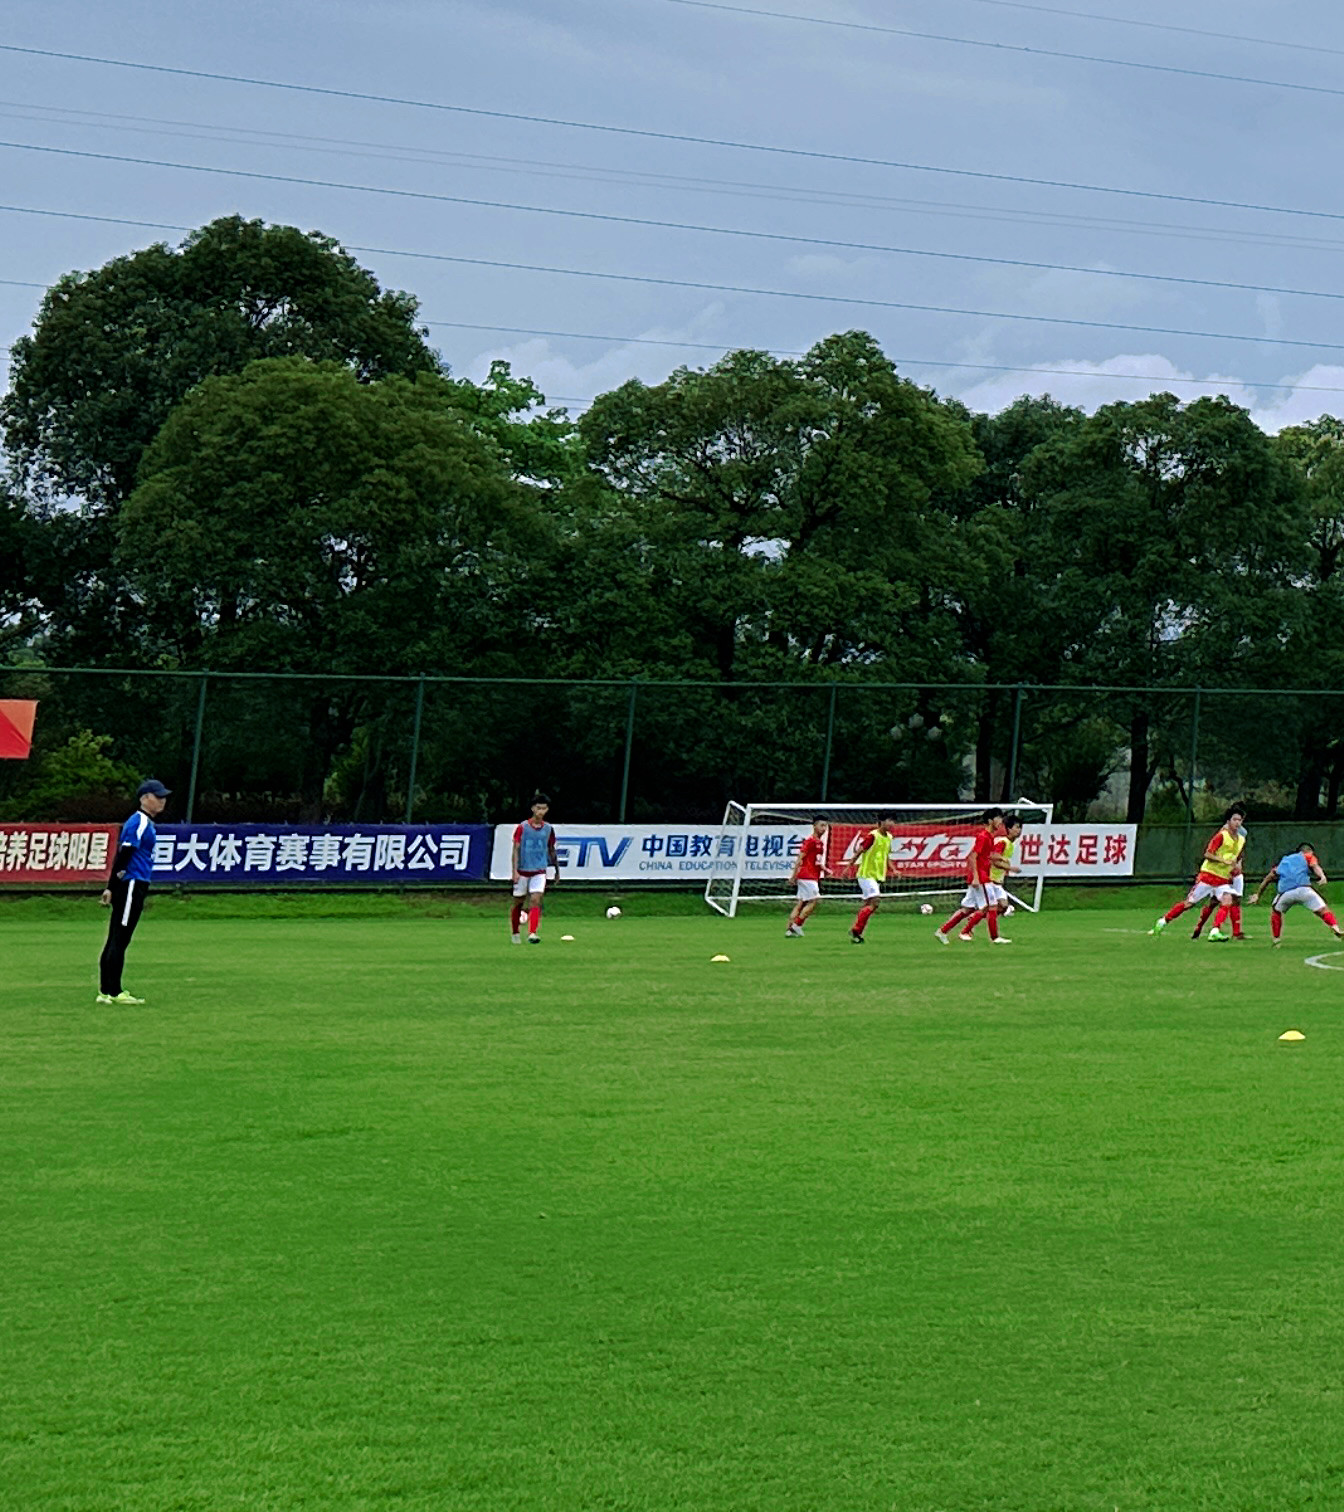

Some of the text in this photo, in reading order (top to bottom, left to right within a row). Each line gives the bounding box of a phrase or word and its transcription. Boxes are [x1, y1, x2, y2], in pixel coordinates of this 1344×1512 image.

[642, 834, 804, 858] 中国教育电视台
[1020, 834, 1127, 865] 世达足球
[639, 861, 673, 871] CHINA
